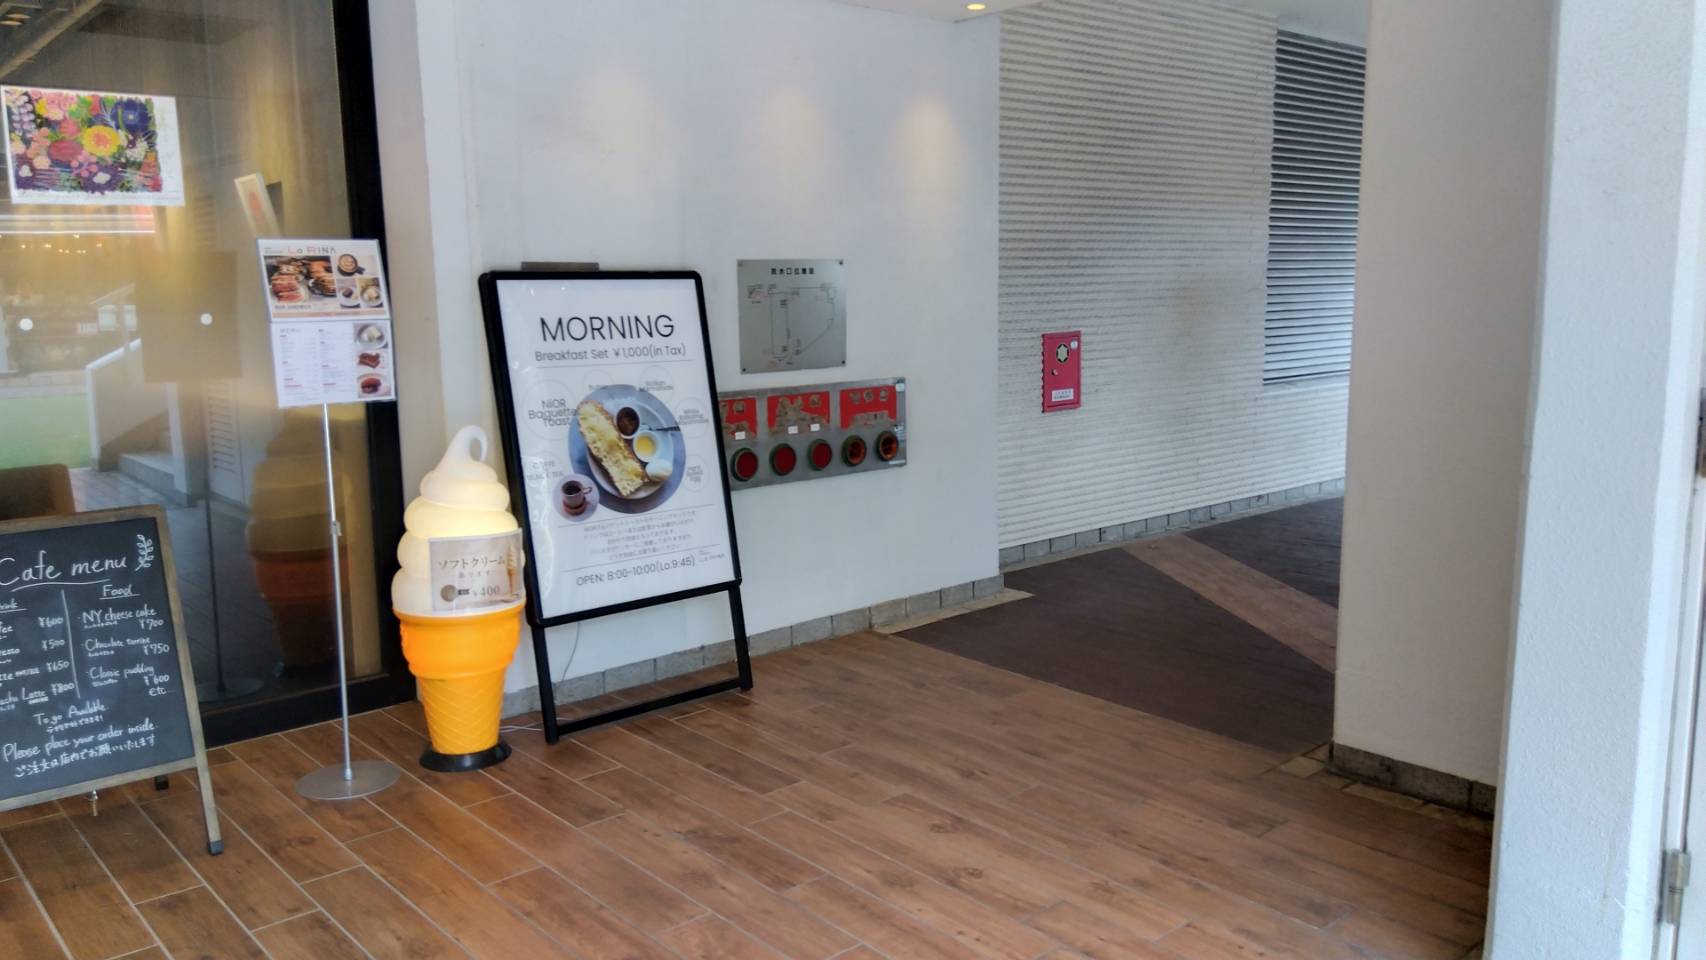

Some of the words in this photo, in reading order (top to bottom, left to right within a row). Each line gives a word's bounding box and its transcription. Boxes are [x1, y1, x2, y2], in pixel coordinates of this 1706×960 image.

[540, 314, 675, 342] MORNING
[534, 349, 588, 362] Breakfast
[591, 349, 609, 360] Set
[0, 550, 62, 586] Cafe
[71, 556, 128, 577] menu
[438, 556, 506, 569] ソフトクリーム
[102, 584, 134, 597] Food
[82, 609, 103, 624] NY
[104, 607, 133, 621] cheese
[135, 603, 157, 618] cake
[139, 619, 164, 630] ¥700
[143, 643, 170, 655] ¥750
[143, 674, 170, 686] ¥600
[3, 743, 41, 762] Please
[45, 735, 71, 756] place
[73, 734, 94, 748] your
[97, 725, 124, 741] order
